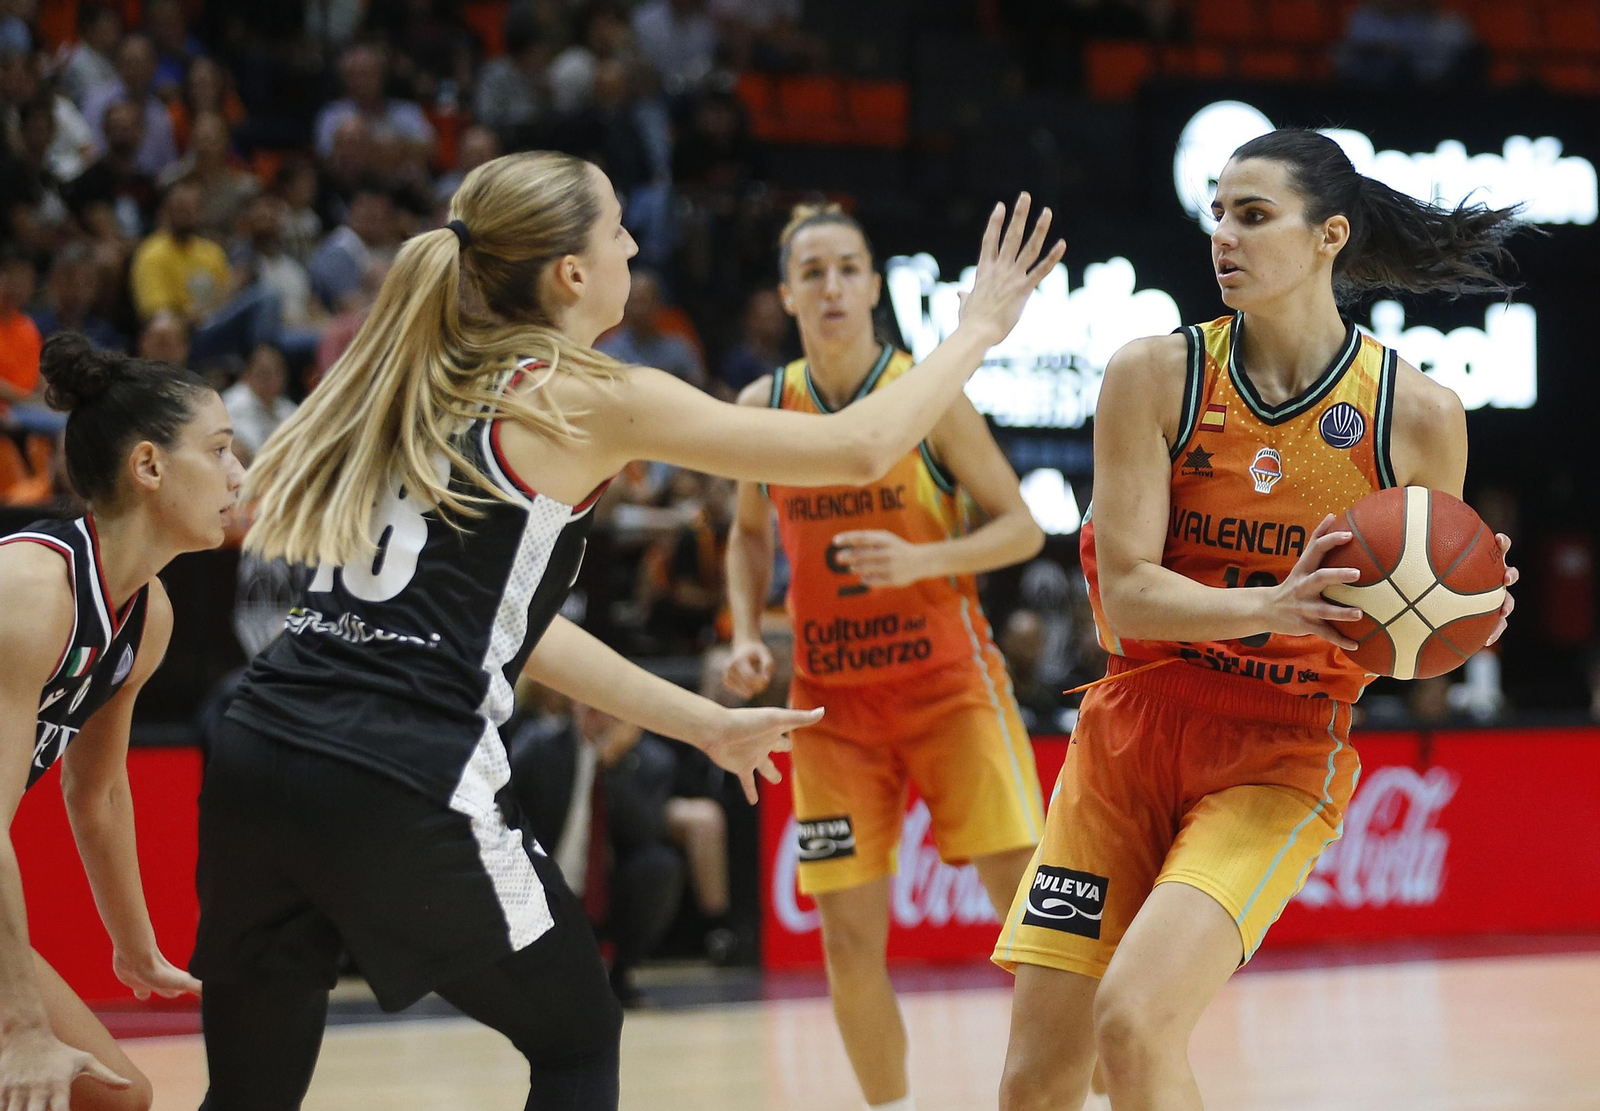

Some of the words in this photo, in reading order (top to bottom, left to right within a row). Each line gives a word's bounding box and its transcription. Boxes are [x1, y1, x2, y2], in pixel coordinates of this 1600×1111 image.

[787, 489, 874, 520] VALENCIA
[1173, 505, 1306, 557] VALENCIA
[804, 613, 898, 645] Cultura
[807, 638, 932, 675] Esfuerzo
[1032, 871, 1101, 903] PULEVA
